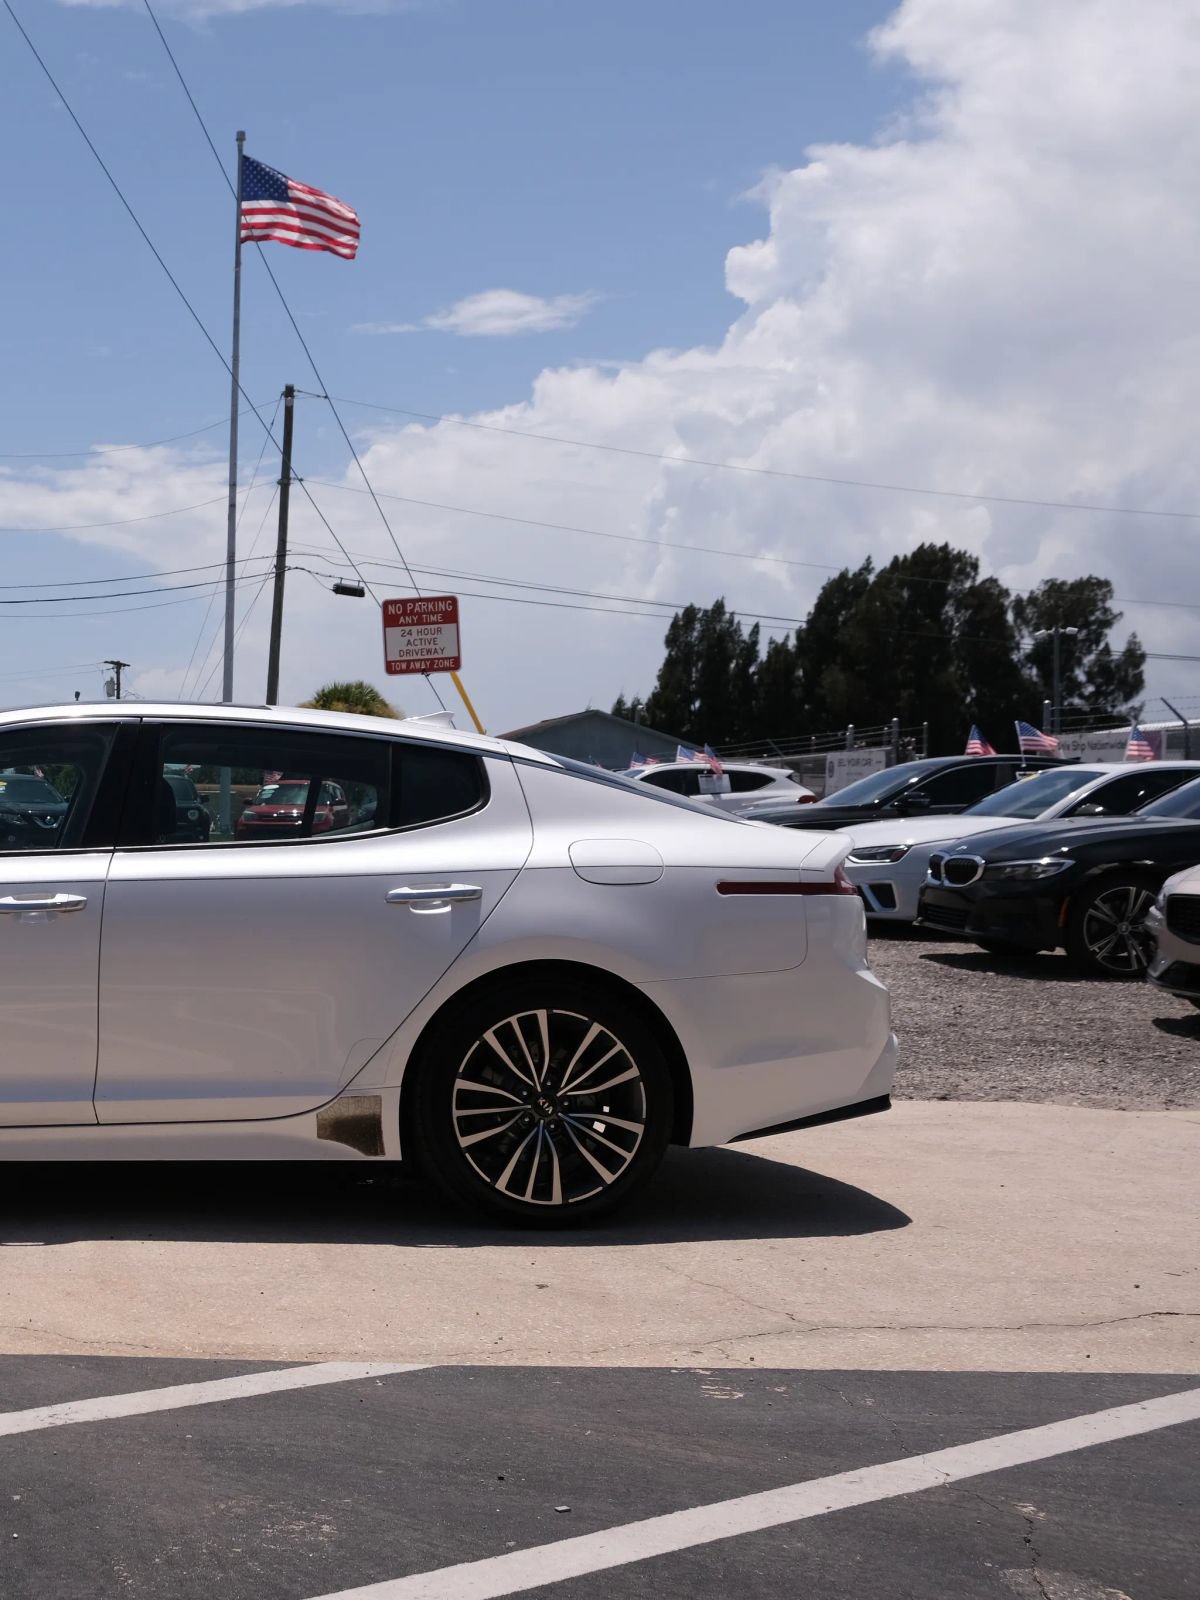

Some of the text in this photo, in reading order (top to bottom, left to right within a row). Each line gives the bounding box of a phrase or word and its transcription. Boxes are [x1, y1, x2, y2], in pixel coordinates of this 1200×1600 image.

[388, 600, 452, 615] NO PARKING
[399, 613, 443, 624] ANY TIME
[400, 627, 442, 637] 24 HOUR
[406, 637, 438, 646] ACTIVE
[399, 647, 445, 657] DRIVEWAY
[391, 658, 455, 671] TOW AWAY ZONE
[537, 1097, 553, 1114] KIA
